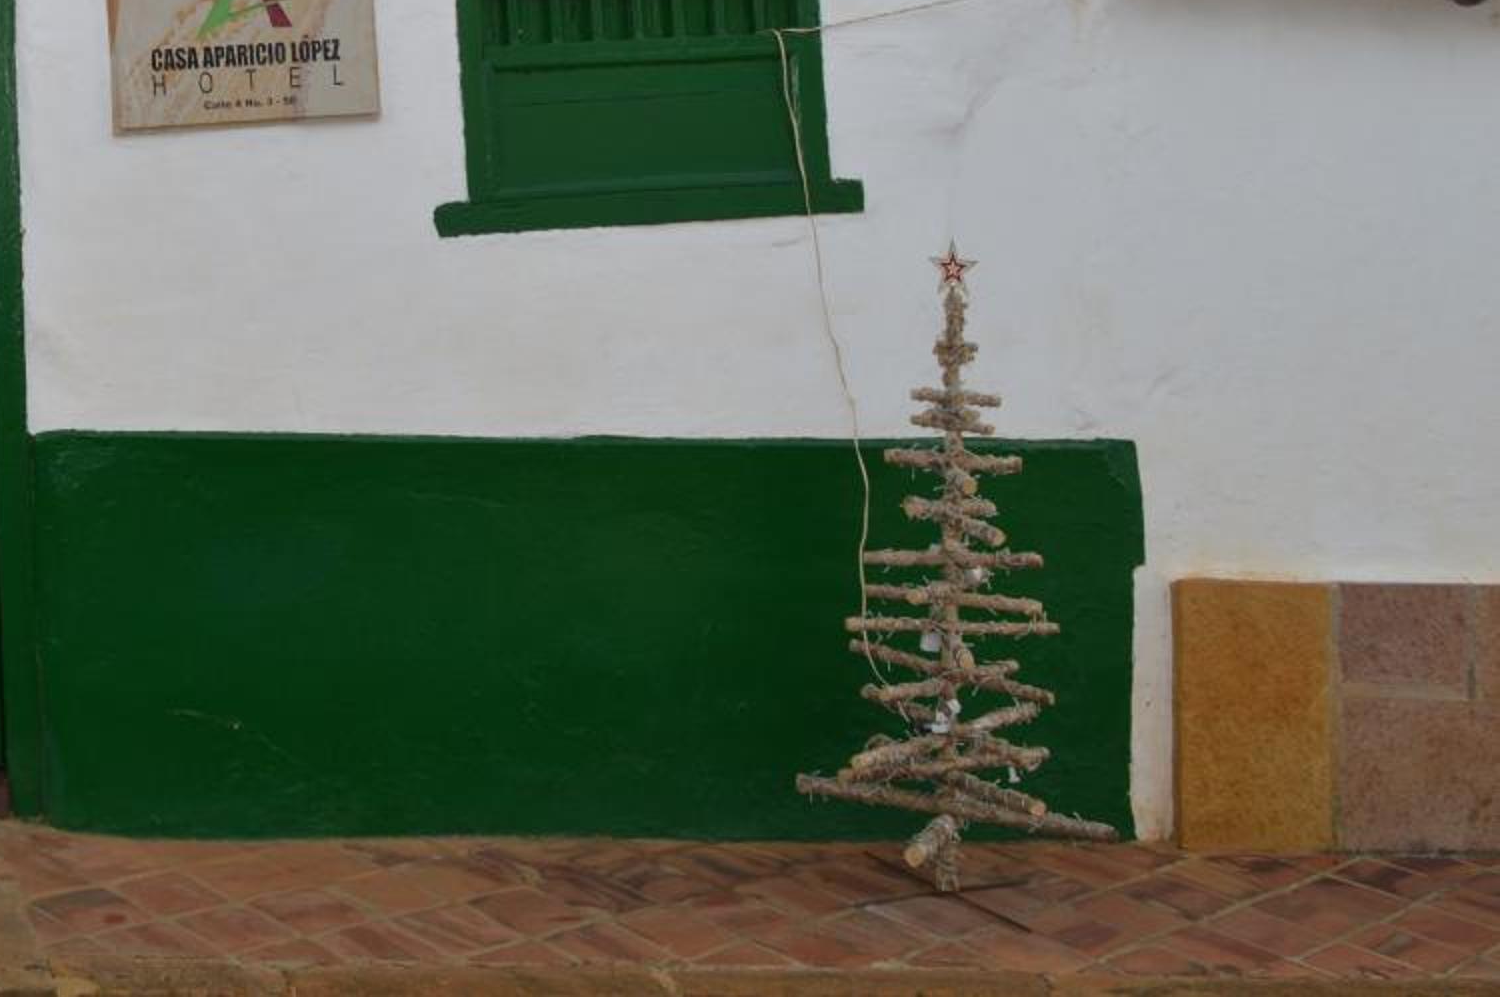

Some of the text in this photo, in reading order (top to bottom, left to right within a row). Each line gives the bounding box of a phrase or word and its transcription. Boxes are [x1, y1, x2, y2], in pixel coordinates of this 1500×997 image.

[151, 34, 341, 72] CASA APARICIO LÓPEZ
[151, 64, 344, 97] HOTEL
